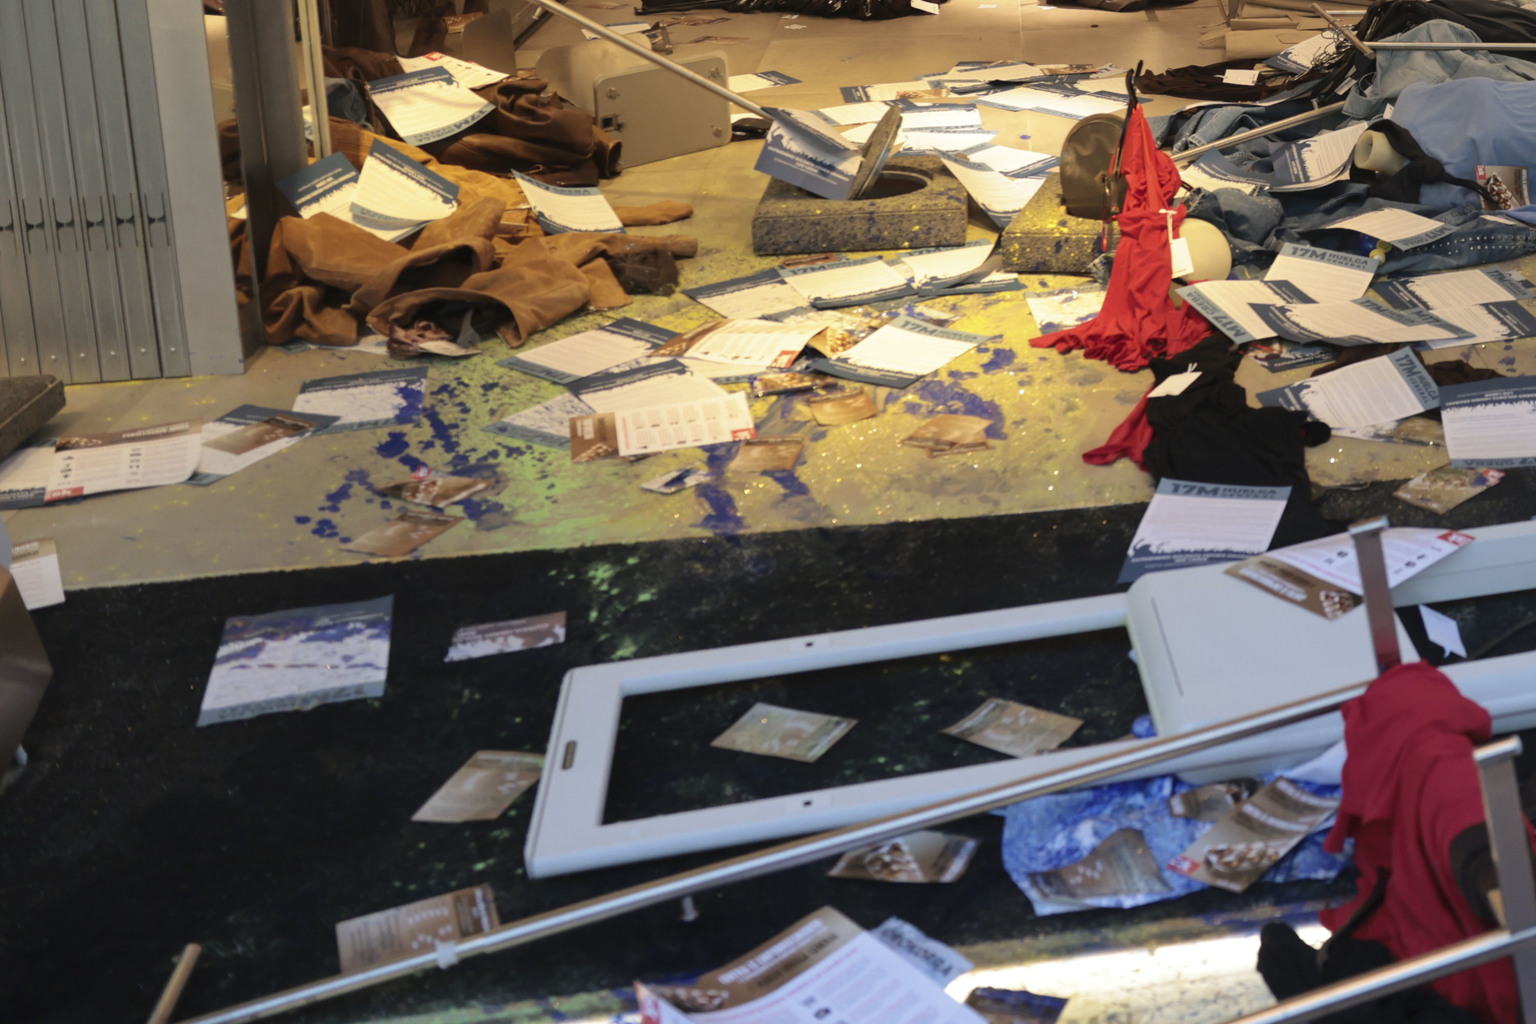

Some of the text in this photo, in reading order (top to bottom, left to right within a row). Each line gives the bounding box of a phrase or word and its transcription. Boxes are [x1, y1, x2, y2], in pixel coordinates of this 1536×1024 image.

[1290, 245, 1328, 263] 17M
[1213, 315, 1243, 339] M17
[1395, 353, 1420, 377] 17M
[1171, 483, 1220, 497] 17M
